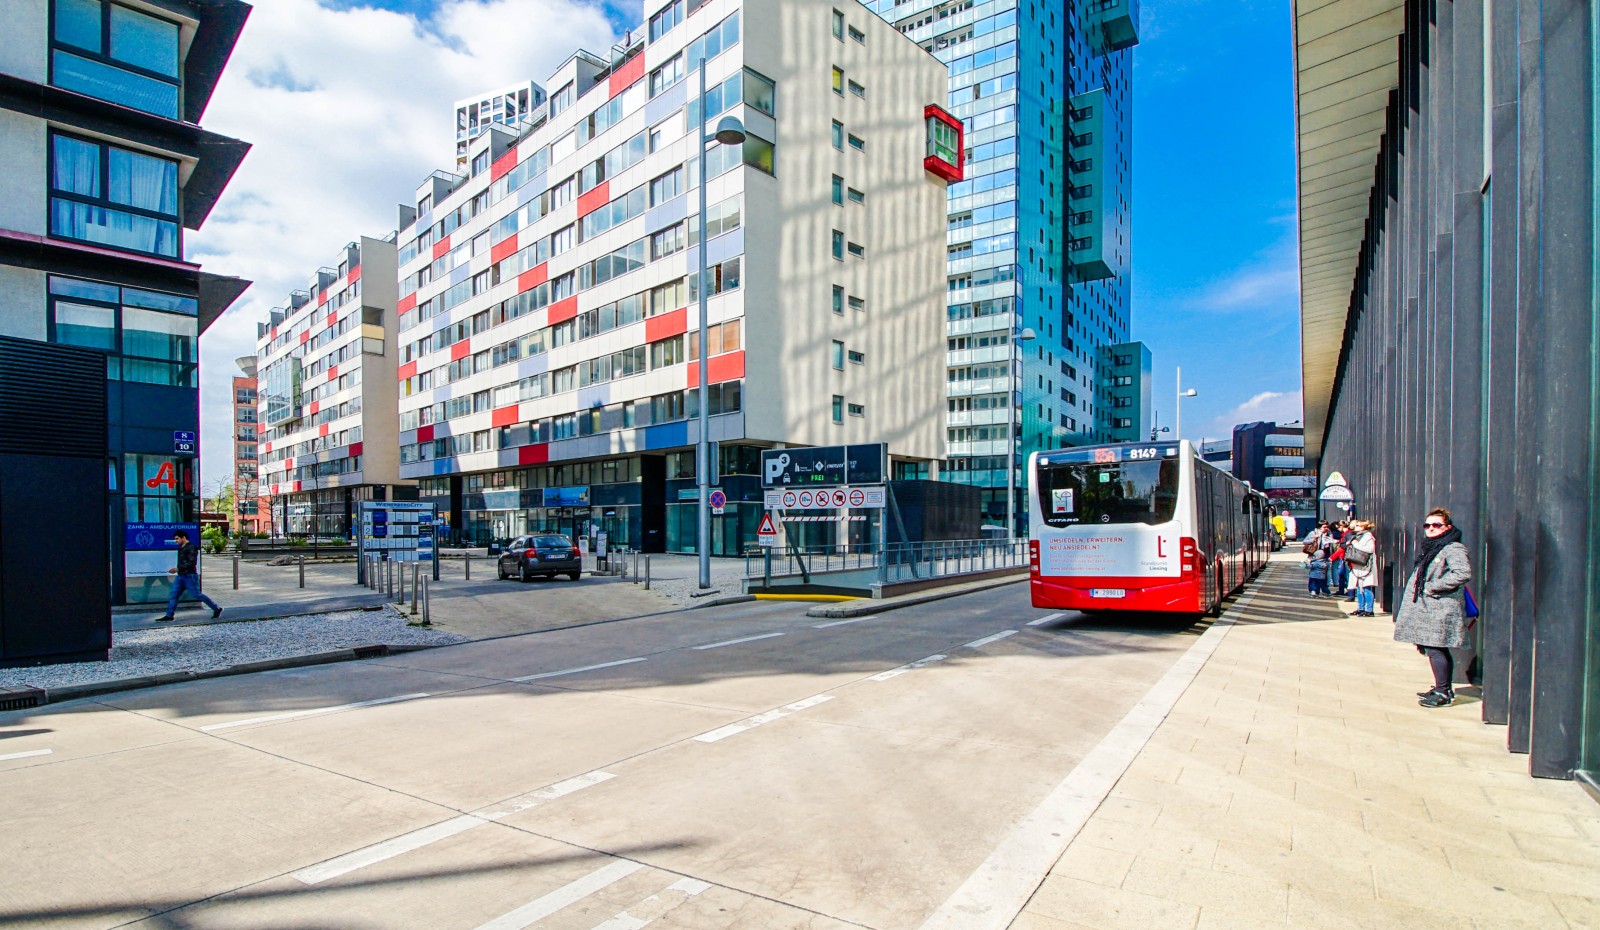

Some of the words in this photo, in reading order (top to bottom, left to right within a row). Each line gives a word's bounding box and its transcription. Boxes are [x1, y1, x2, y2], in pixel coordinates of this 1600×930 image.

[179, 443, 190, 451] 10
[1130, 448, 1157, 459] 8149
[146, 461, 179, 489] A
[365, 541, 371, 549] 3
